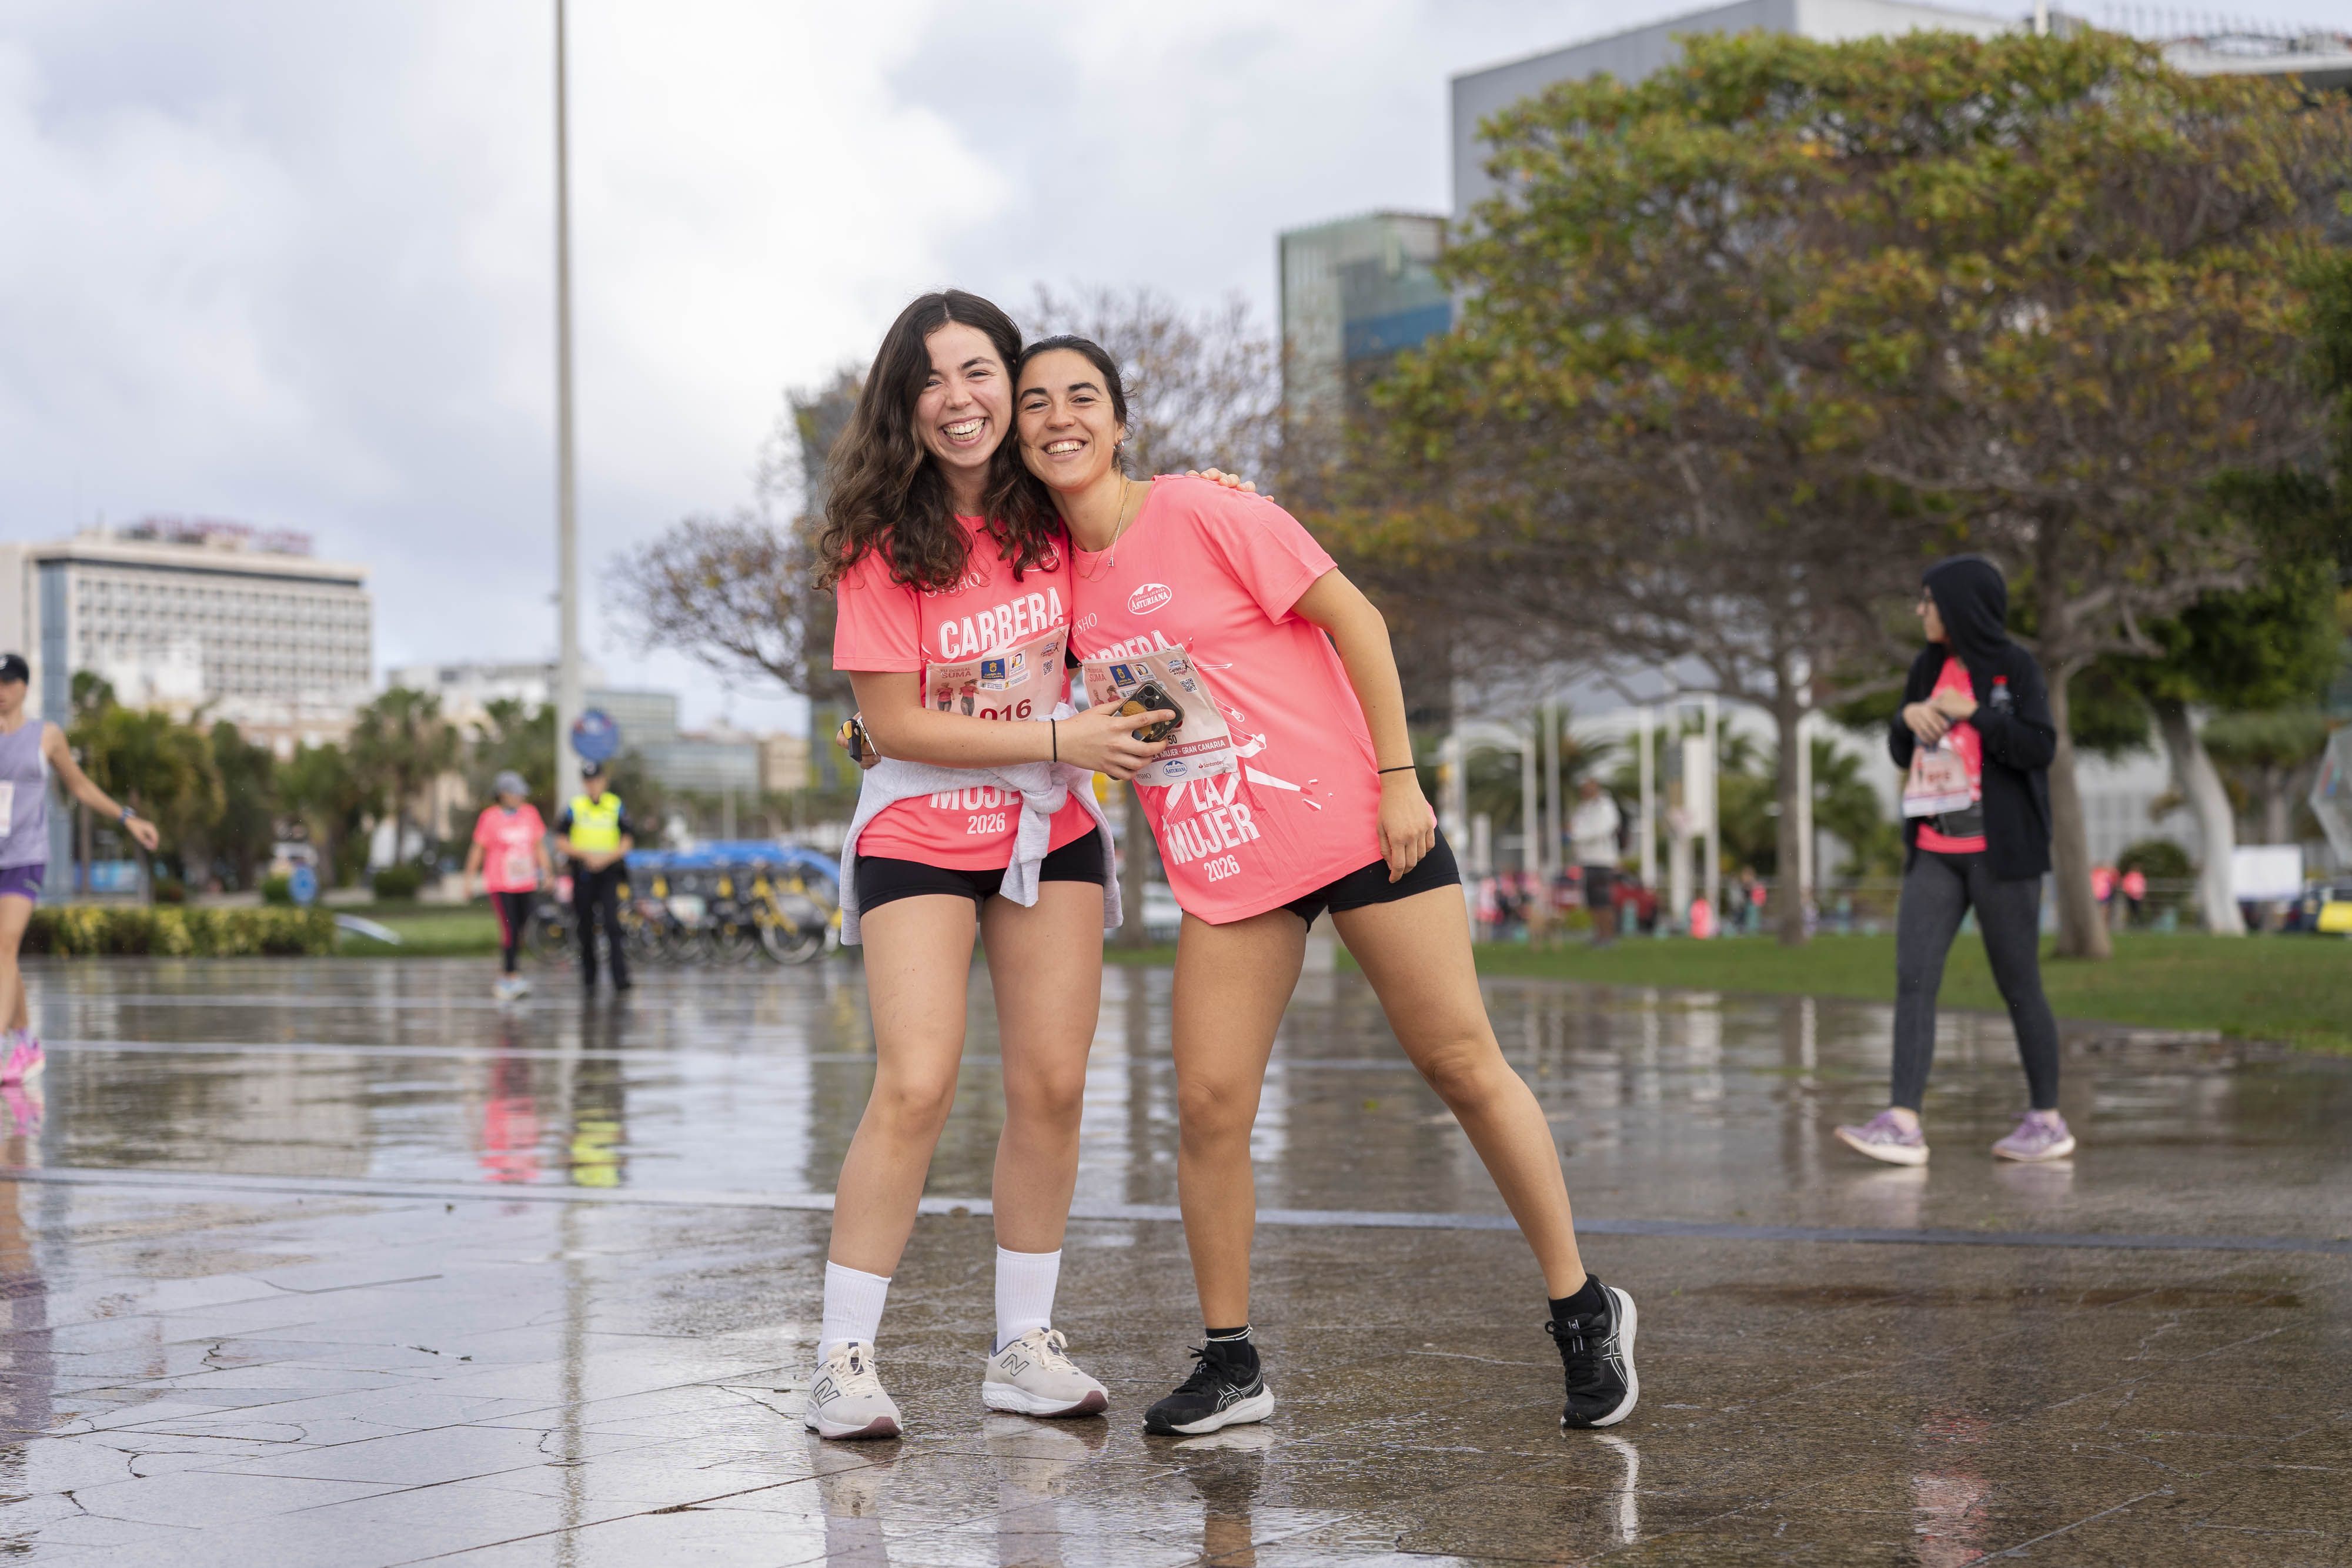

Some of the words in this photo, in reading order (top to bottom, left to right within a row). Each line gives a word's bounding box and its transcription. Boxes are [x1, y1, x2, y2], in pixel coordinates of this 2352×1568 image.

[925, 573, 980, 597] OSHO
[1131, 591, 1169, 611] ASTURIANA
[938, 587, 1064, 659] CARRERA
[1089, 673, 1107, 682] SUMA
[1160, 748, 1178, 758] MUJER
[1182, 745, 1198, 754] GRAN
[1198, 740, 1226, 751] CANARIA
[1165, 766, 1186, 774] ASTURIANA
[1203, 760, 1224, 768] Santander
[929, 785, 1024, 811] MUJ
[1190, 777, 1224, 813] LA
[967, 812, 1006, 834] 2026
[1167, 802, 1261, 865] MUJER
[1204, 854, 1241, 882] 2026
